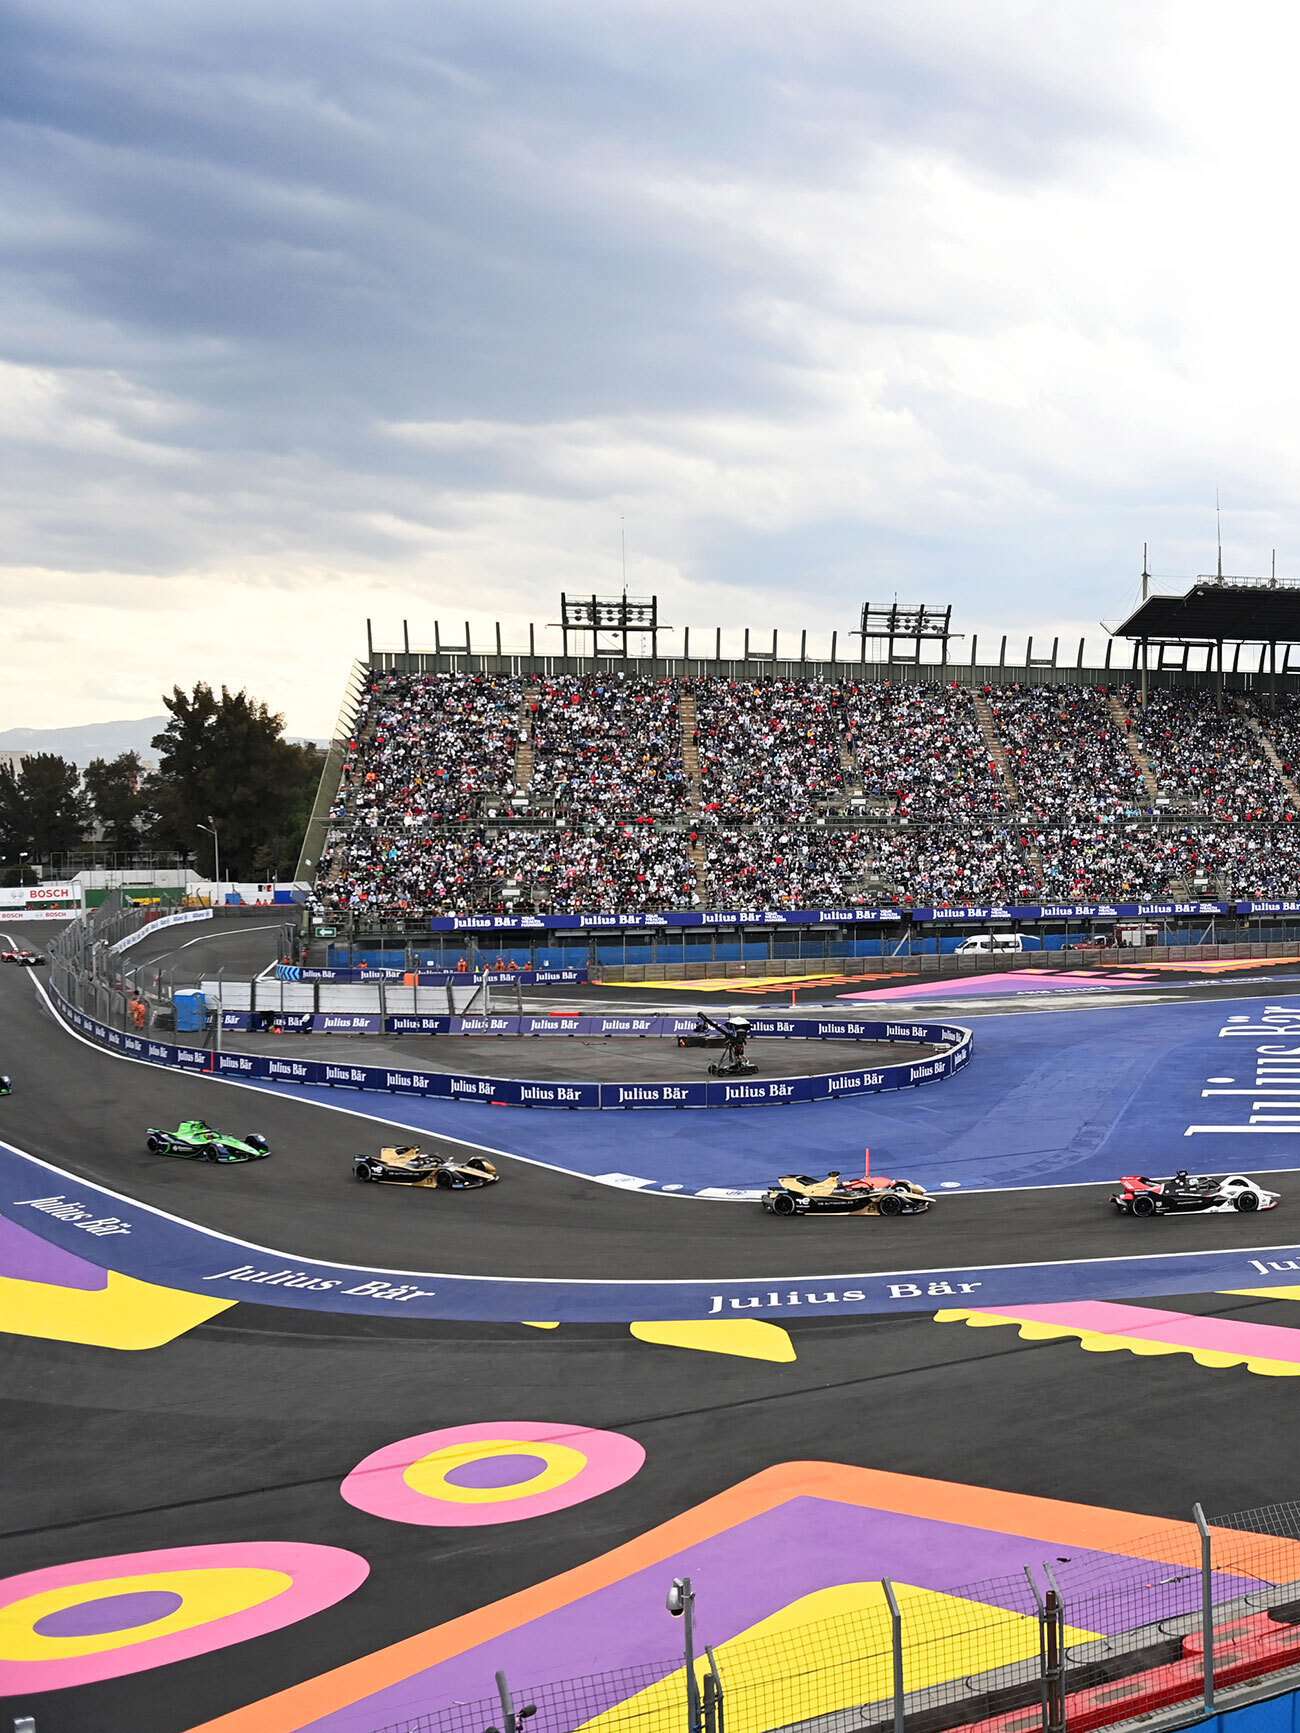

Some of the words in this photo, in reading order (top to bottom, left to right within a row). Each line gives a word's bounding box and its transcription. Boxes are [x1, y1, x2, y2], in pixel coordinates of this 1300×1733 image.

[30, 889, 68, 898] BOSCH
[1041, 906, 1072, 917] Julius
[1075, 906, 1096, 915] Bär
[1138, 904, 1174, 915] Julius
[1176, 904, 1196, 914] Bär
[1251, 902, 1281, 912] Julius
[1283, 901, 1300, 910] Bär
[702, 913, 736, 924] Julius
[740, 912, 761, 922] Bär
[820, 911, 853, 922] Julius
[856, 910, 877, 919] Bär
[933, 908, 965, 919] Julius
[968, 907, 988, 917] Bär
[454, 918, 491, 929] Julius
[493, 917, 518, 926] Bär
[580, 916, 616, 926] Julius
[618, 914, 641, 925] Bär
[500, 974, 515, 982] Bär
[536, 971, 559, 982] Julius
[562, 971, 577, 980] Bär
[225, 1015, 239, 1024] Bär
[324, 1018, 351, 1028] Julius
[353, 1018, 370, 1027] Bär
[422, 1019, 440, 1028] Bär
[490, 1020, 509, 1029] Bär
[531, 1020, 558, 1030] Julius
[560, 1020, 579, 1029] Bär
[602, 1020, 630, 1031] Julius
[632, 1020, 651, 1029] Bär
[777, 1022, 794, 1032] Bär
[818, 1024, 845, 1034] Julius
[847, 1023, 865, 1034] Bär
[886, 1025, 910, 1036] Julius
[912, 1027, 927, 1037] Bär
[178, 1050, 193, 1062] Julius
[194, 1052, 205, 1064] Bär
[220, 1056, 239, 1068] Julius
[240, 1058, 253, 1070] Bär
[269, 1061, 291, 1074] Julius
[293, 1063, 307, 1076] Bär
[326, 1066, 350, 1079] Julius
[351, 1069, 366, 1082] Bär
[911, 1067, 933, 1081] Julius
[934, 1062, 946, 1074] Bär
[387, 1073, 411, 1086] Julius
[413, 1076, 429, 1088] Bär
[828, 1078, 861, 1093] Julius
[864, 1074, 884, 1086] Bär
[451, 1079, 477, 1093] Julius
[478, 1082, 495, 1095] Bär
[726, 1085, 766, 1100] Julius
[769, 1084, 794, 1097] Bär
[521, 1086, 554, 1101] Julius
[557, 1088, 581, 1100] Bär
[619, 1088, 659, 1102] Julius
[663, 1087, 688, 1100] Bär
[14, 1195, 85, 1228] Julius
[75, 1216, 132, 1237] Bär
[203, 1264, 343, 1290] Julius
[341, 1279, 436, 1302] Bär
[708, 1288, 867, 1314] Julius
[886, 1278, 984, 1298] Bär
